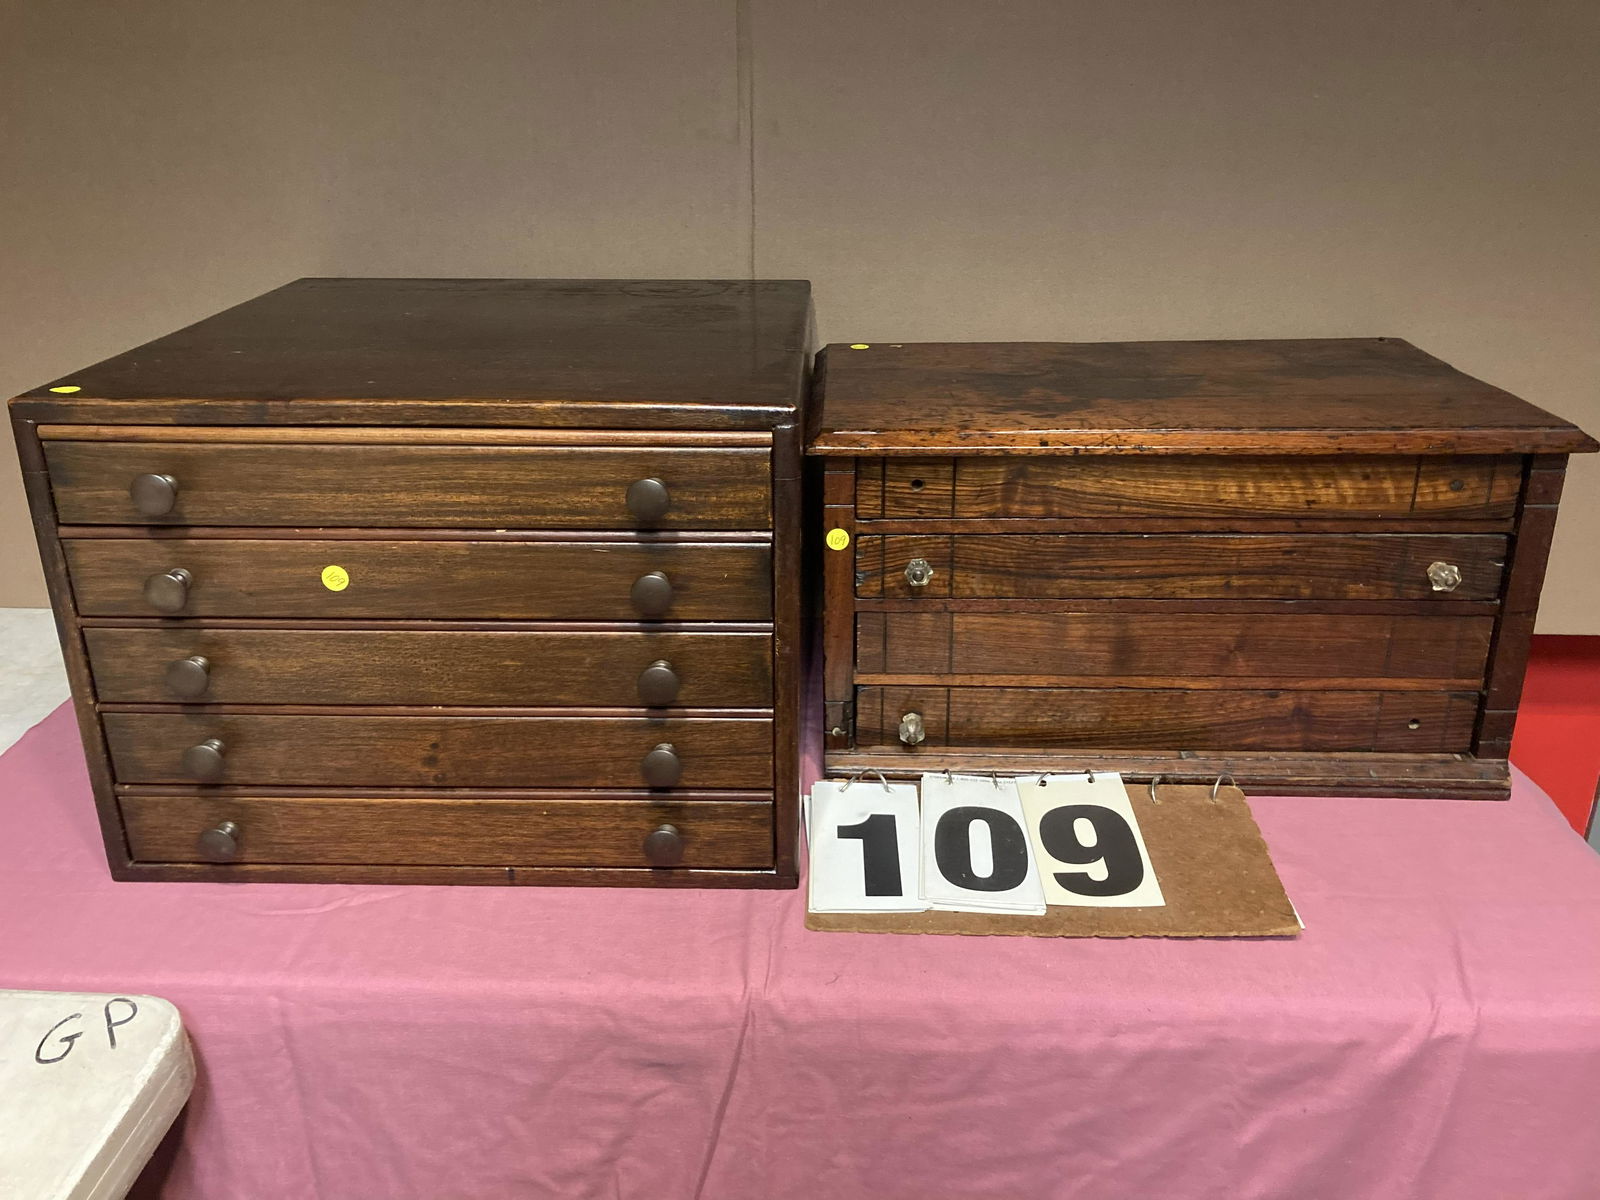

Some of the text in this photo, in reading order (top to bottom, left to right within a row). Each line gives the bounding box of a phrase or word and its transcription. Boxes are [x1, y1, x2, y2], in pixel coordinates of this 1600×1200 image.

[830, 534, 847, 546] 109
[326, 571, 345, 586] 109
[837, 804, 1144, 897] 109
